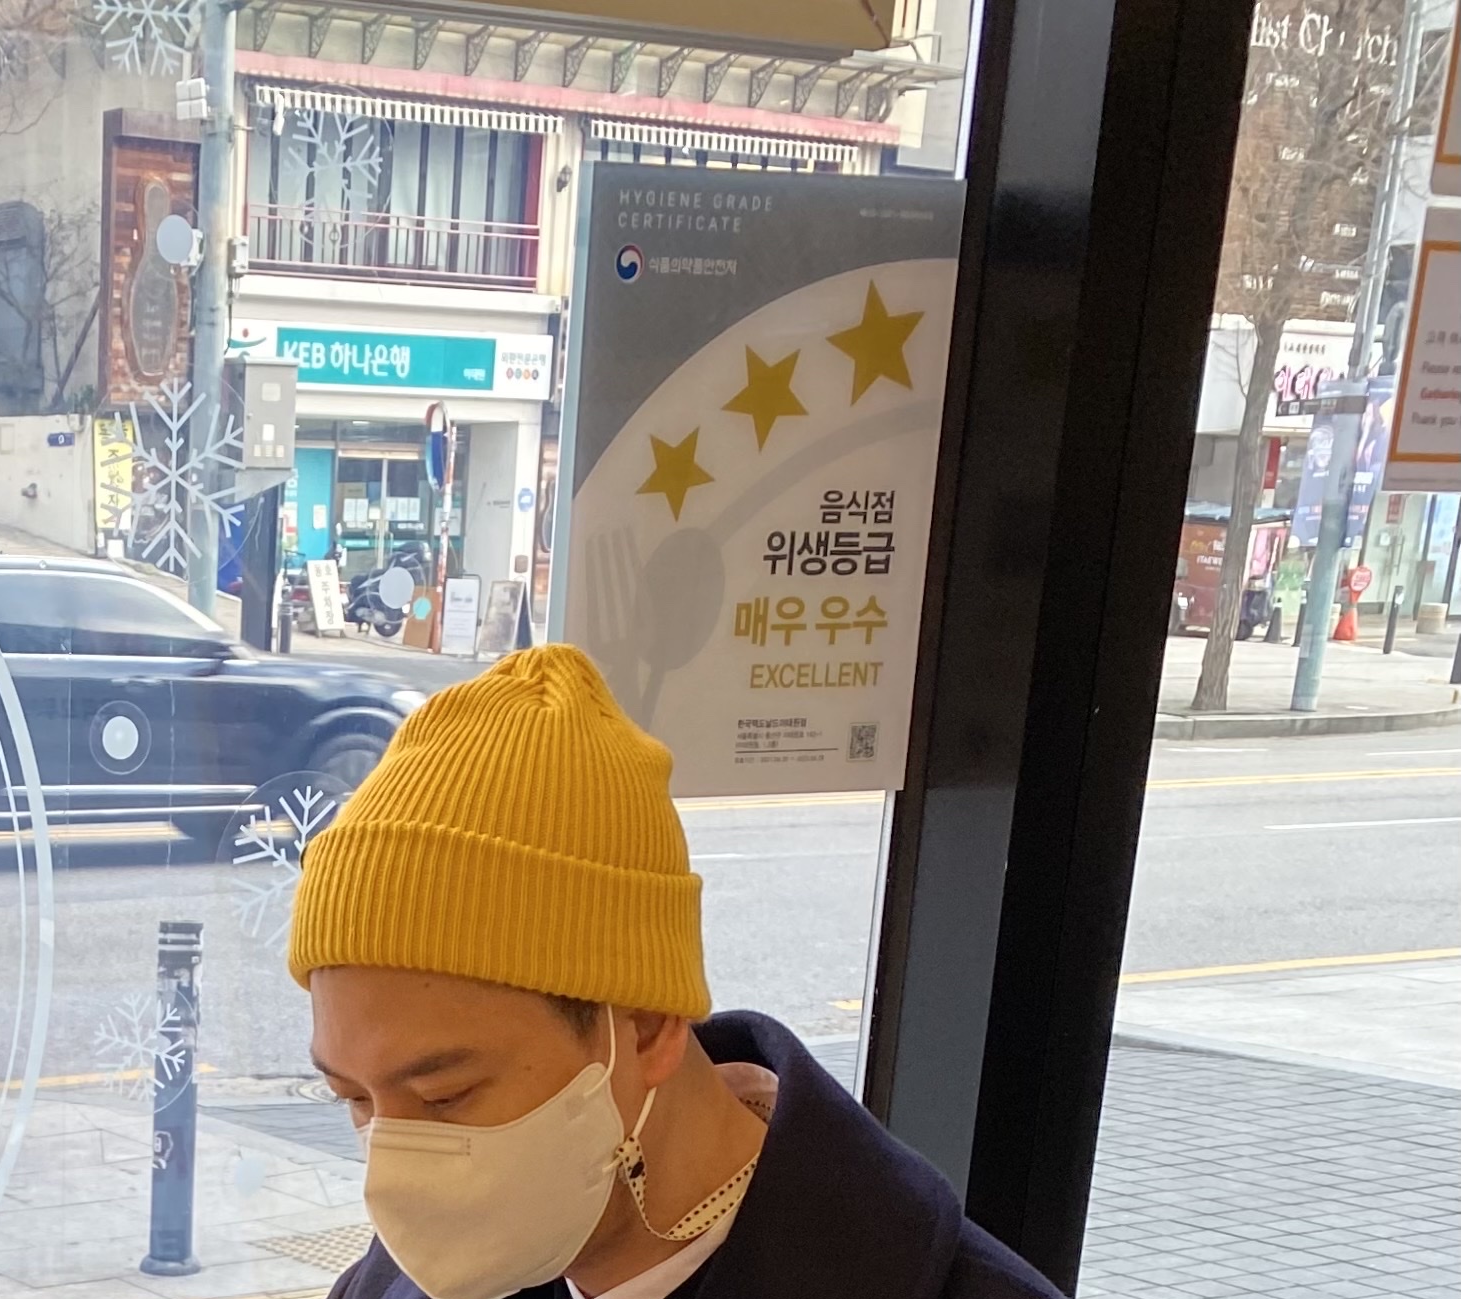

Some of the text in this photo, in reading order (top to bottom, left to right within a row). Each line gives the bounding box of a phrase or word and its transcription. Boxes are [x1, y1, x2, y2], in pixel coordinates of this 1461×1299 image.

[619, 189, 773, 212] HYGIENE GRADE
[617, 211, 743, 233] CERTIFICATE
[284, 340, 411, 378] KEB 하나은행
[820, 490, 896, 524] 음식점
[763, 530, 896, 576] 위생등급
[734, 595, 888, 647] 매우 우수
[750, 662, 884, 689] EXCELLENT
